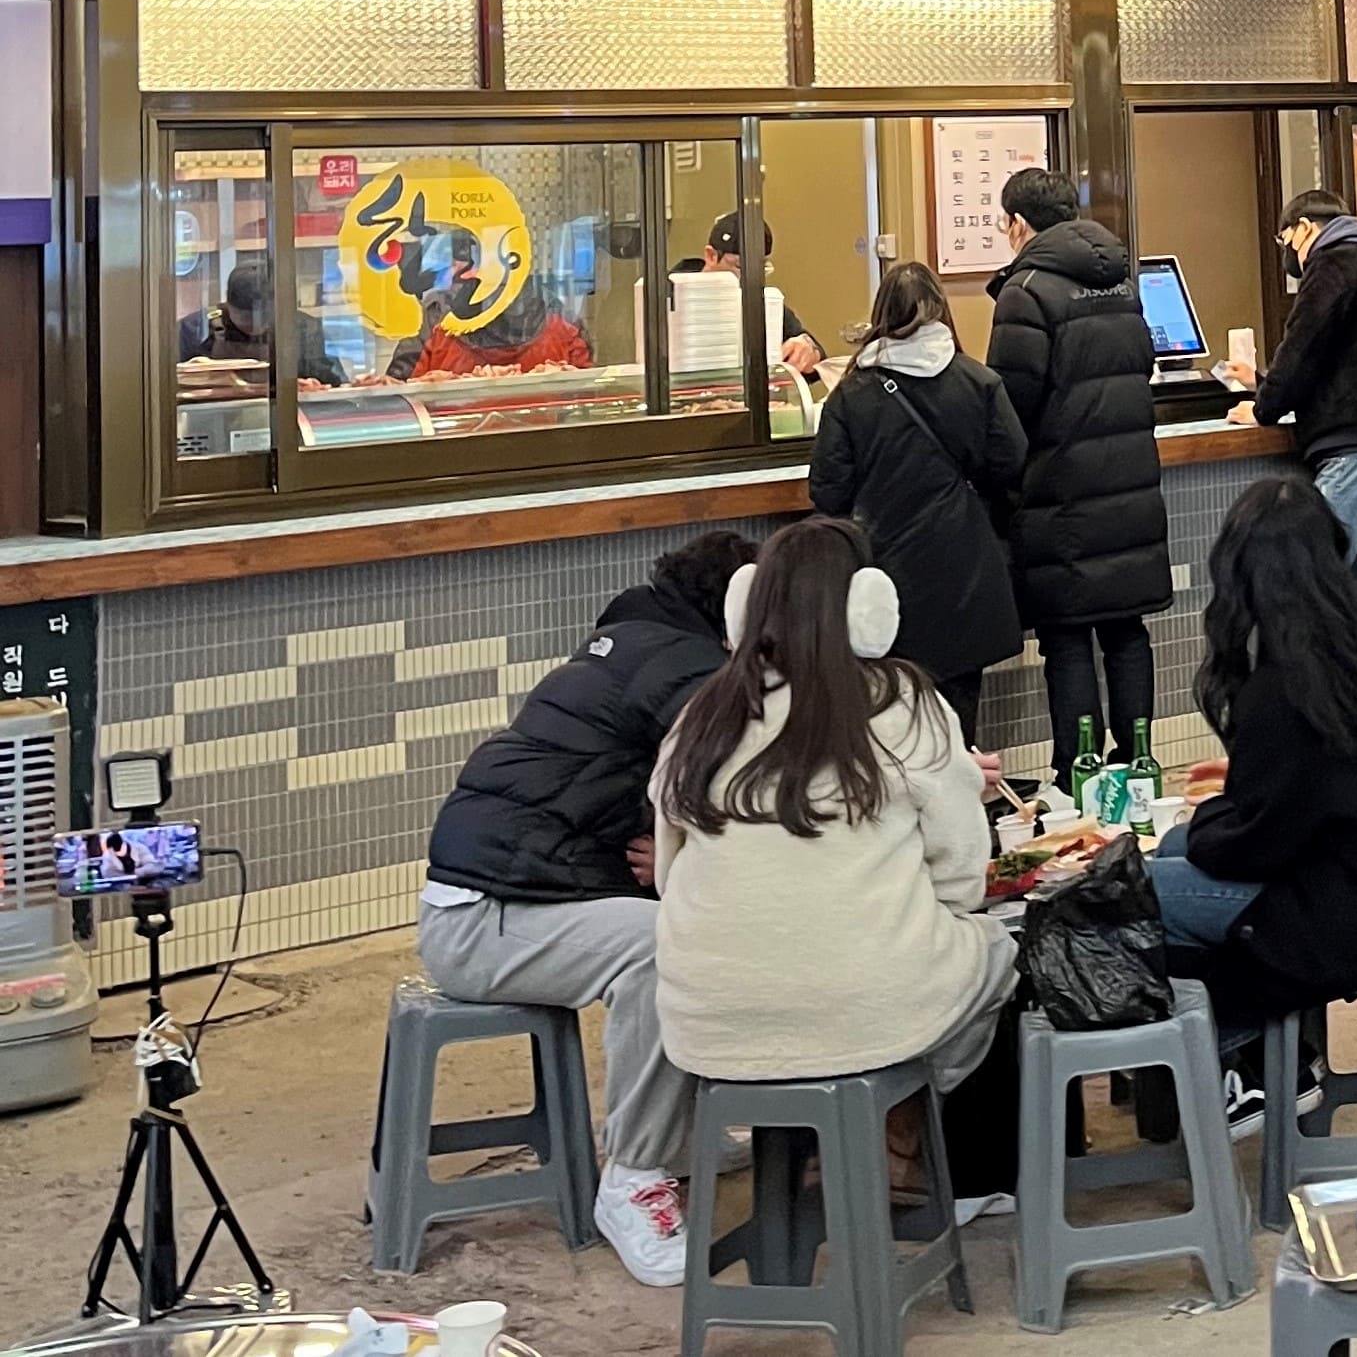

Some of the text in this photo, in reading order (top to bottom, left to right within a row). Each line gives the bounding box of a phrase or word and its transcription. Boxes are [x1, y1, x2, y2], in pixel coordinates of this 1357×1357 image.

[323, 159, 354, 175] 우리
[323, 175, 355, 188] 돼지
[451, 191, 495, 204] KOREA
[451, 208, 487, 219] PORK
[47, 613, 70, 635] 다
